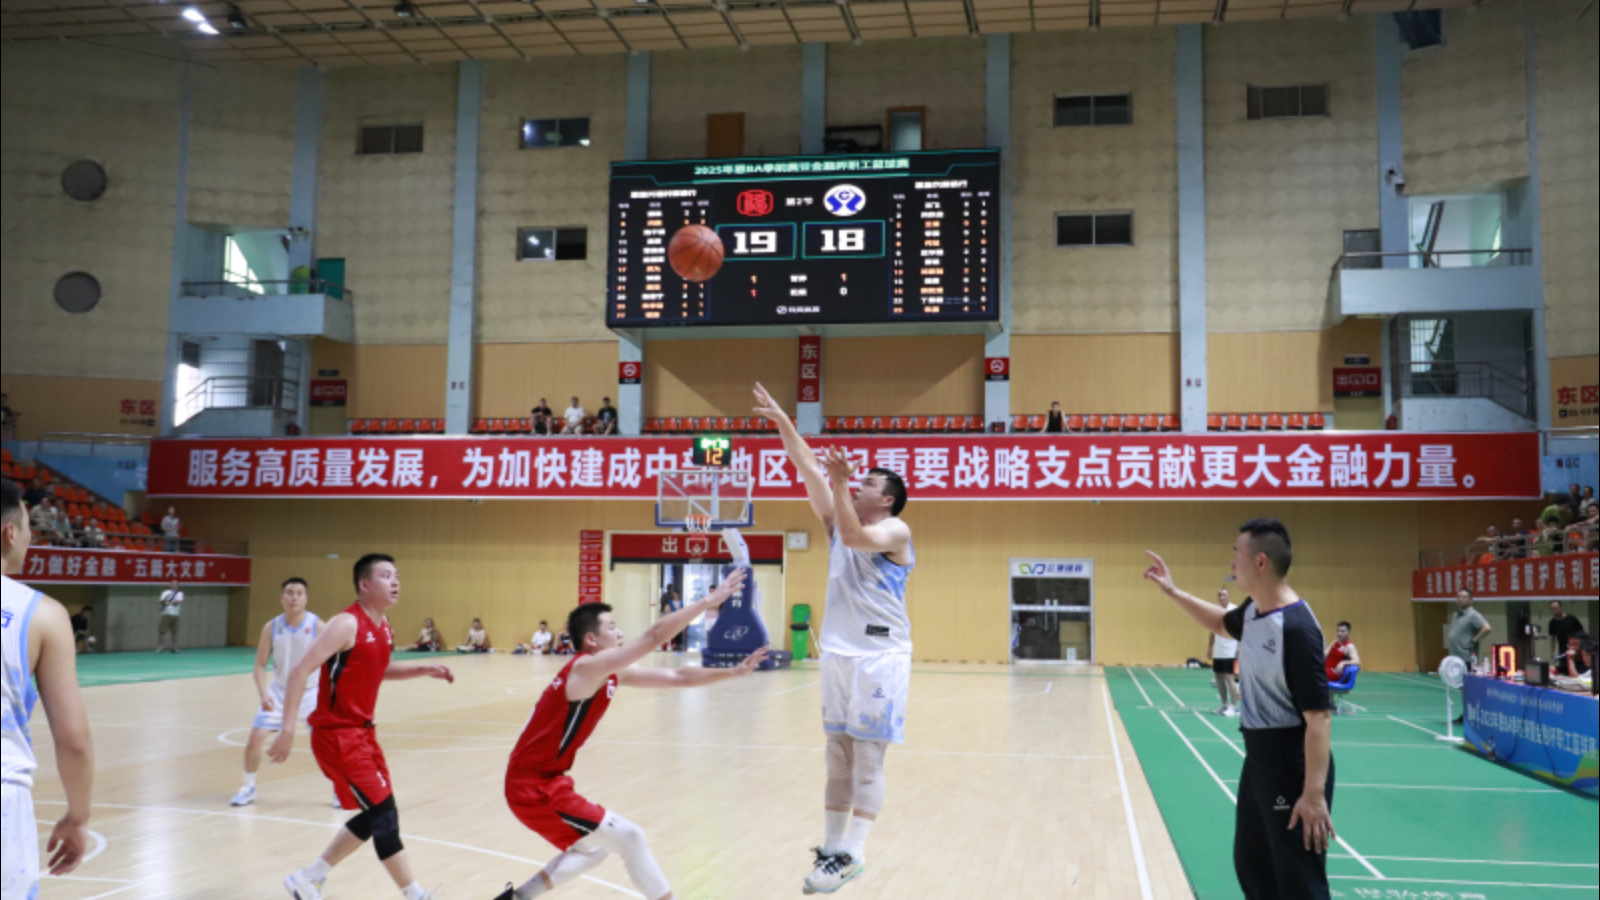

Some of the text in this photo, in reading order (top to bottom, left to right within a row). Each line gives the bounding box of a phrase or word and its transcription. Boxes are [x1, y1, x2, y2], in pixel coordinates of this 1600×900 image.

[733, 231, 777, 254] 19
[820, 228, 865, 252] 18
[750, 275, 757, 284] 1
[840, 273, 847, 282] 1
[750, 288, 757, 298] 1
[839, 286, 848, 296] 0
[801, 344, 817, 379] 东区
[1557, 385, 1599, 406] 东区
[120, 398, 156, 416] 东区
[705, 447, 724, 465] 12
